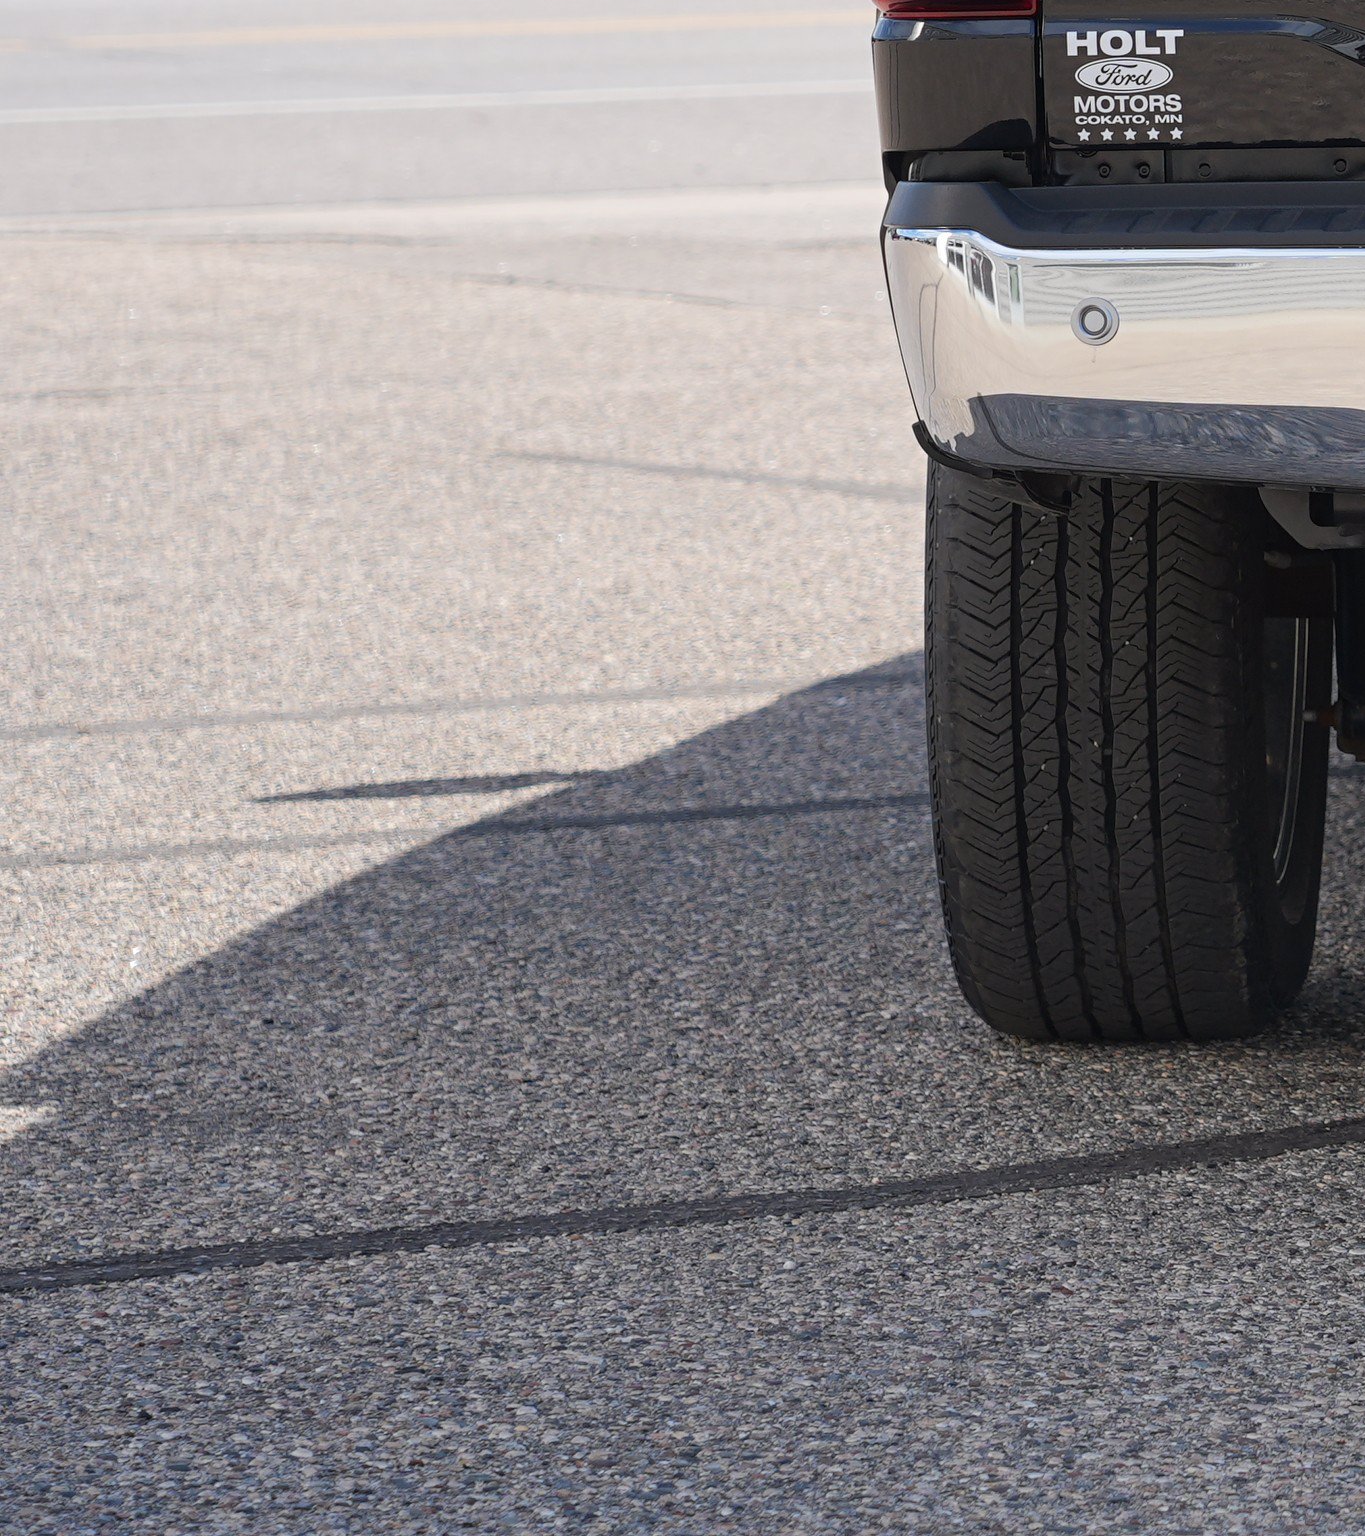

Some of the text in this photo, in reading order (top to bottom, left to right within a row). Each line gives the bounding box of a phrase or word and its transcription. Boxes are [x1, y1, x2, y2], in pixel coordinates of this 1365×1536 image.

[1066, 29, 1184, 57] HOLT
[1095, 63, 1153, 86] Ford
[1073, 94, 1182, 114] MOTORS
[1075, 114, 1183, 126] COKATO, MN
